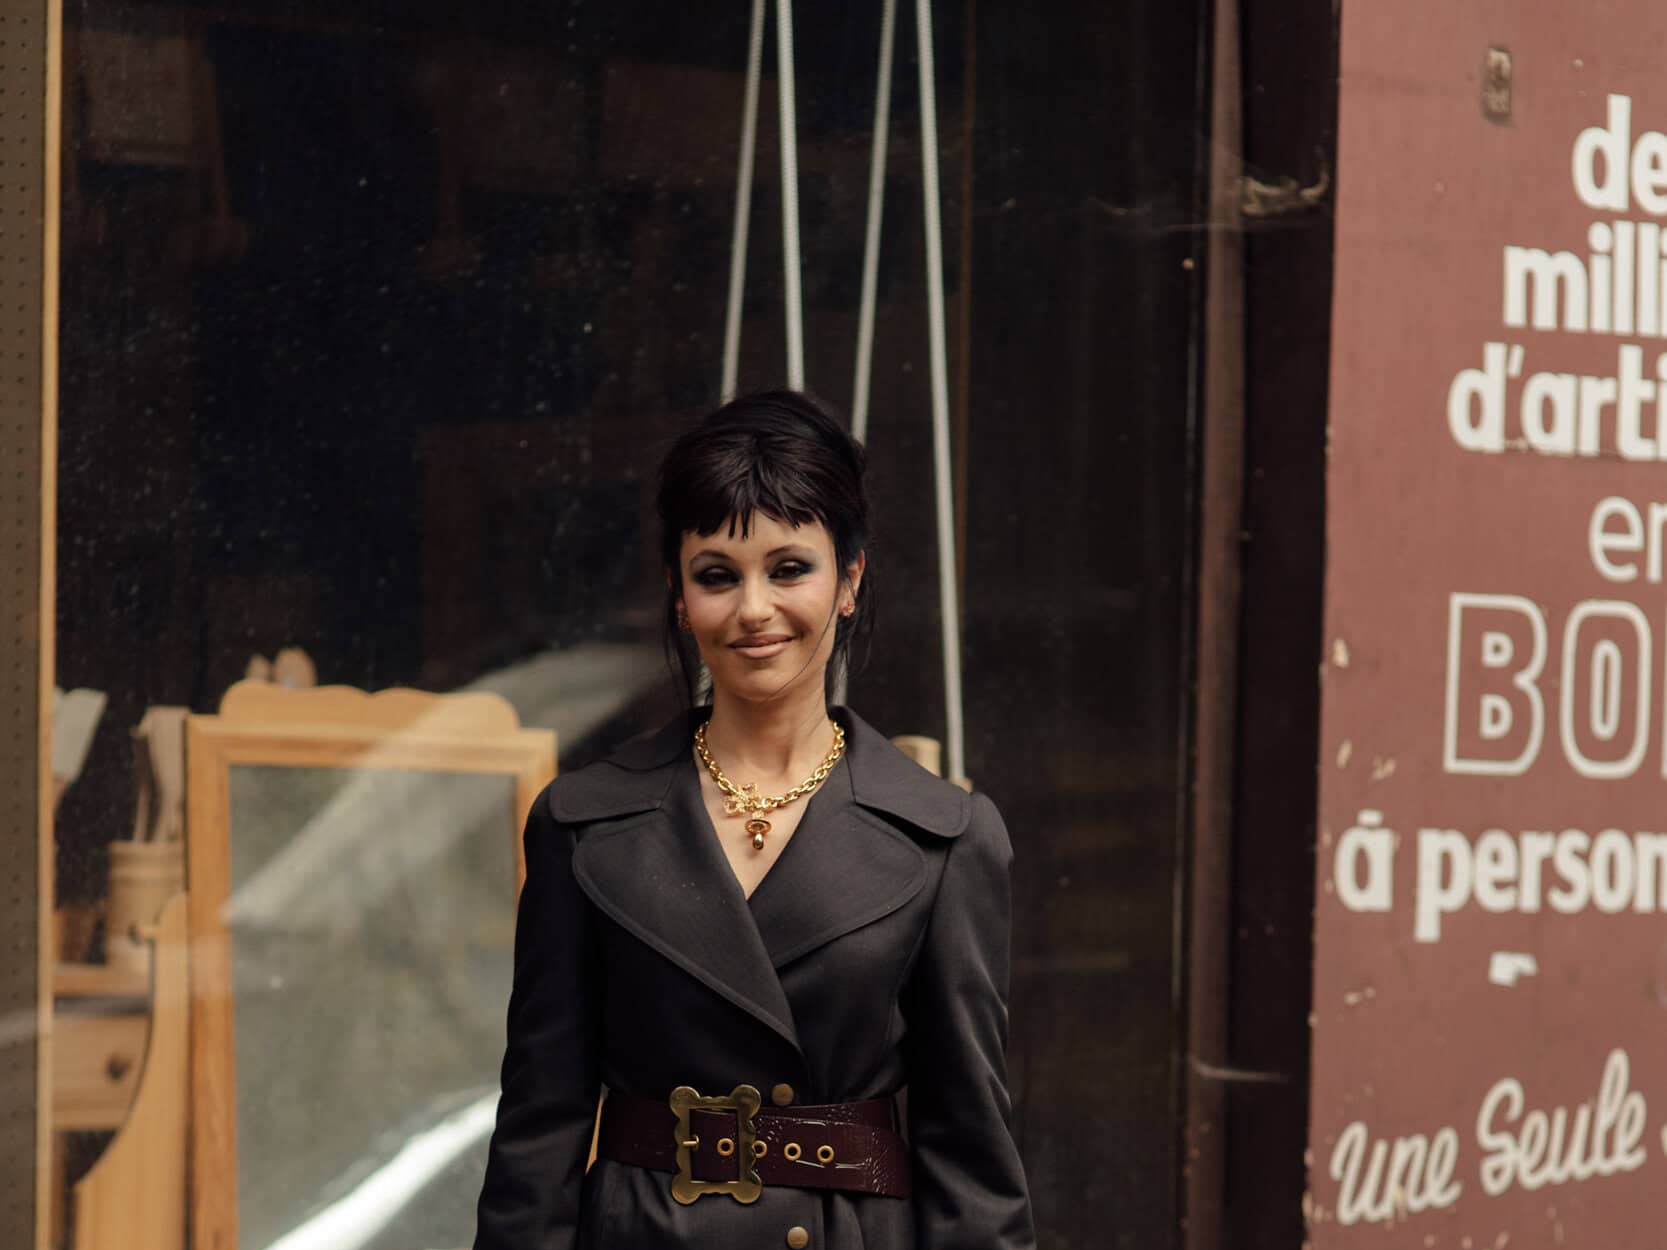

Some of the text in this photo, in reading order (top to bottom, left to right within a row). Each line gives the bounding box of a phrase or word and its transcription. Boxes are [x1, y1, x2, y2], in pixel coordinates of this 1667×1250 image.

[1572, 94, 1667, 216] de
[1443, 592, 1667, 779] BO
[1414, 829, 1667, 943] person
[1330, 1121, 1461, 1226] Une
